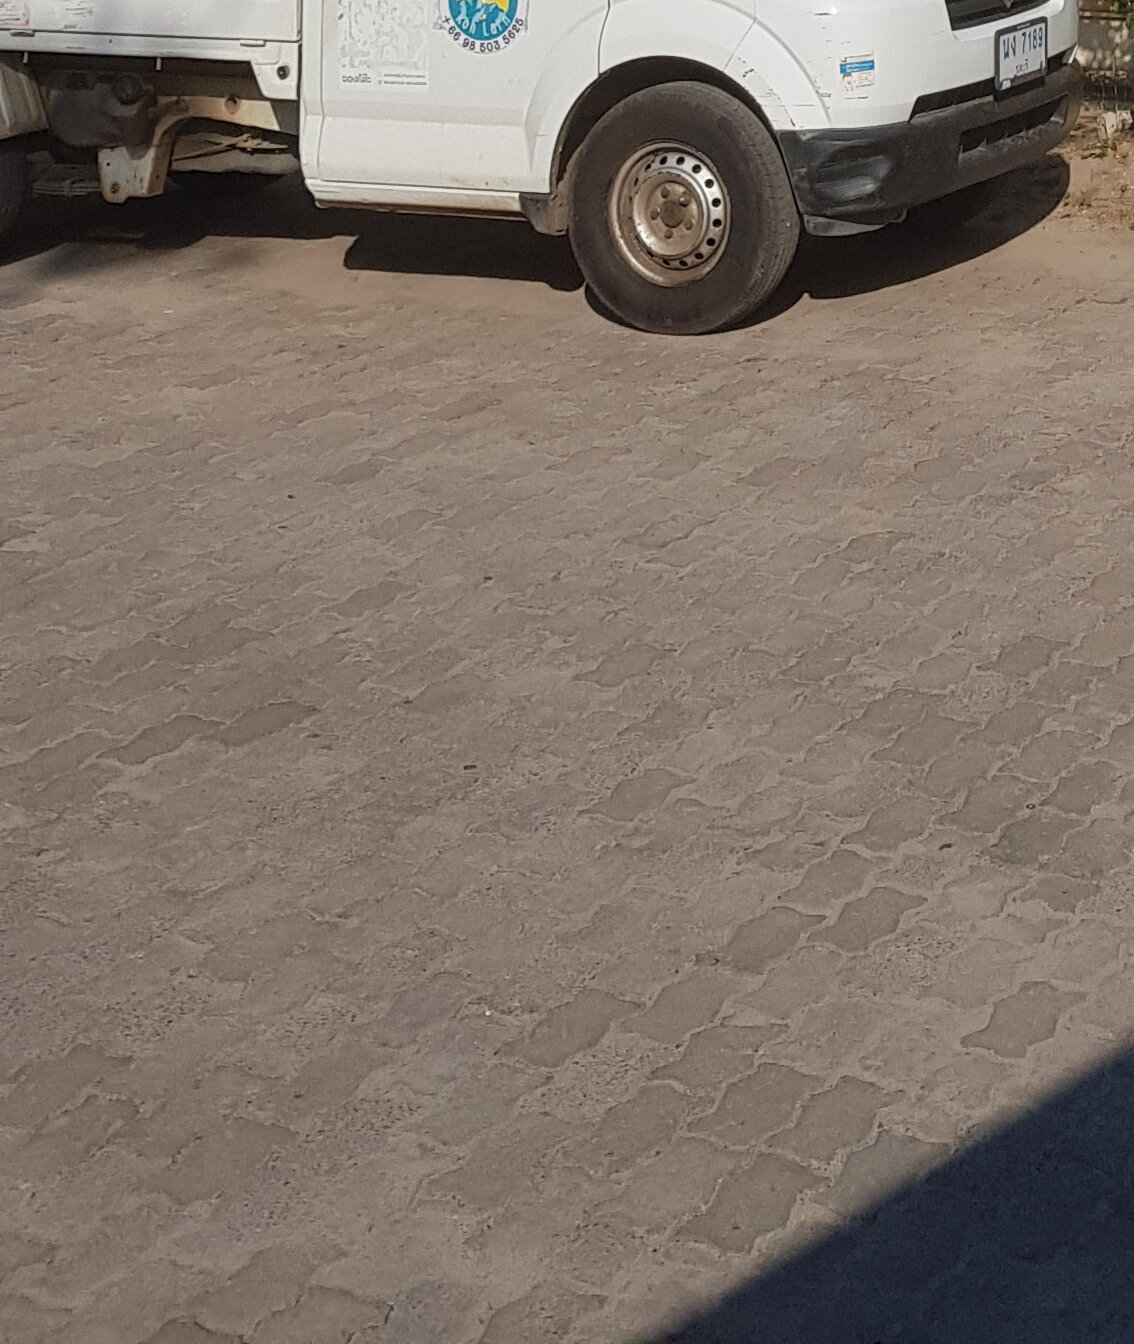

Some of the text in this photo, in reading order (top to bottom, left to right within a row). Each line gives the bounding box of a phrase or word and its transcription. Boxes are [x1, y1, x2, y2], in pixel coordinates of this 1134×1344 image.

[462, 37, 475, 51] 98
[480, 41, 500, 53] 503
[503, 17, 524, 44] 5625
[1022, 27, 1043, 54] 7189
